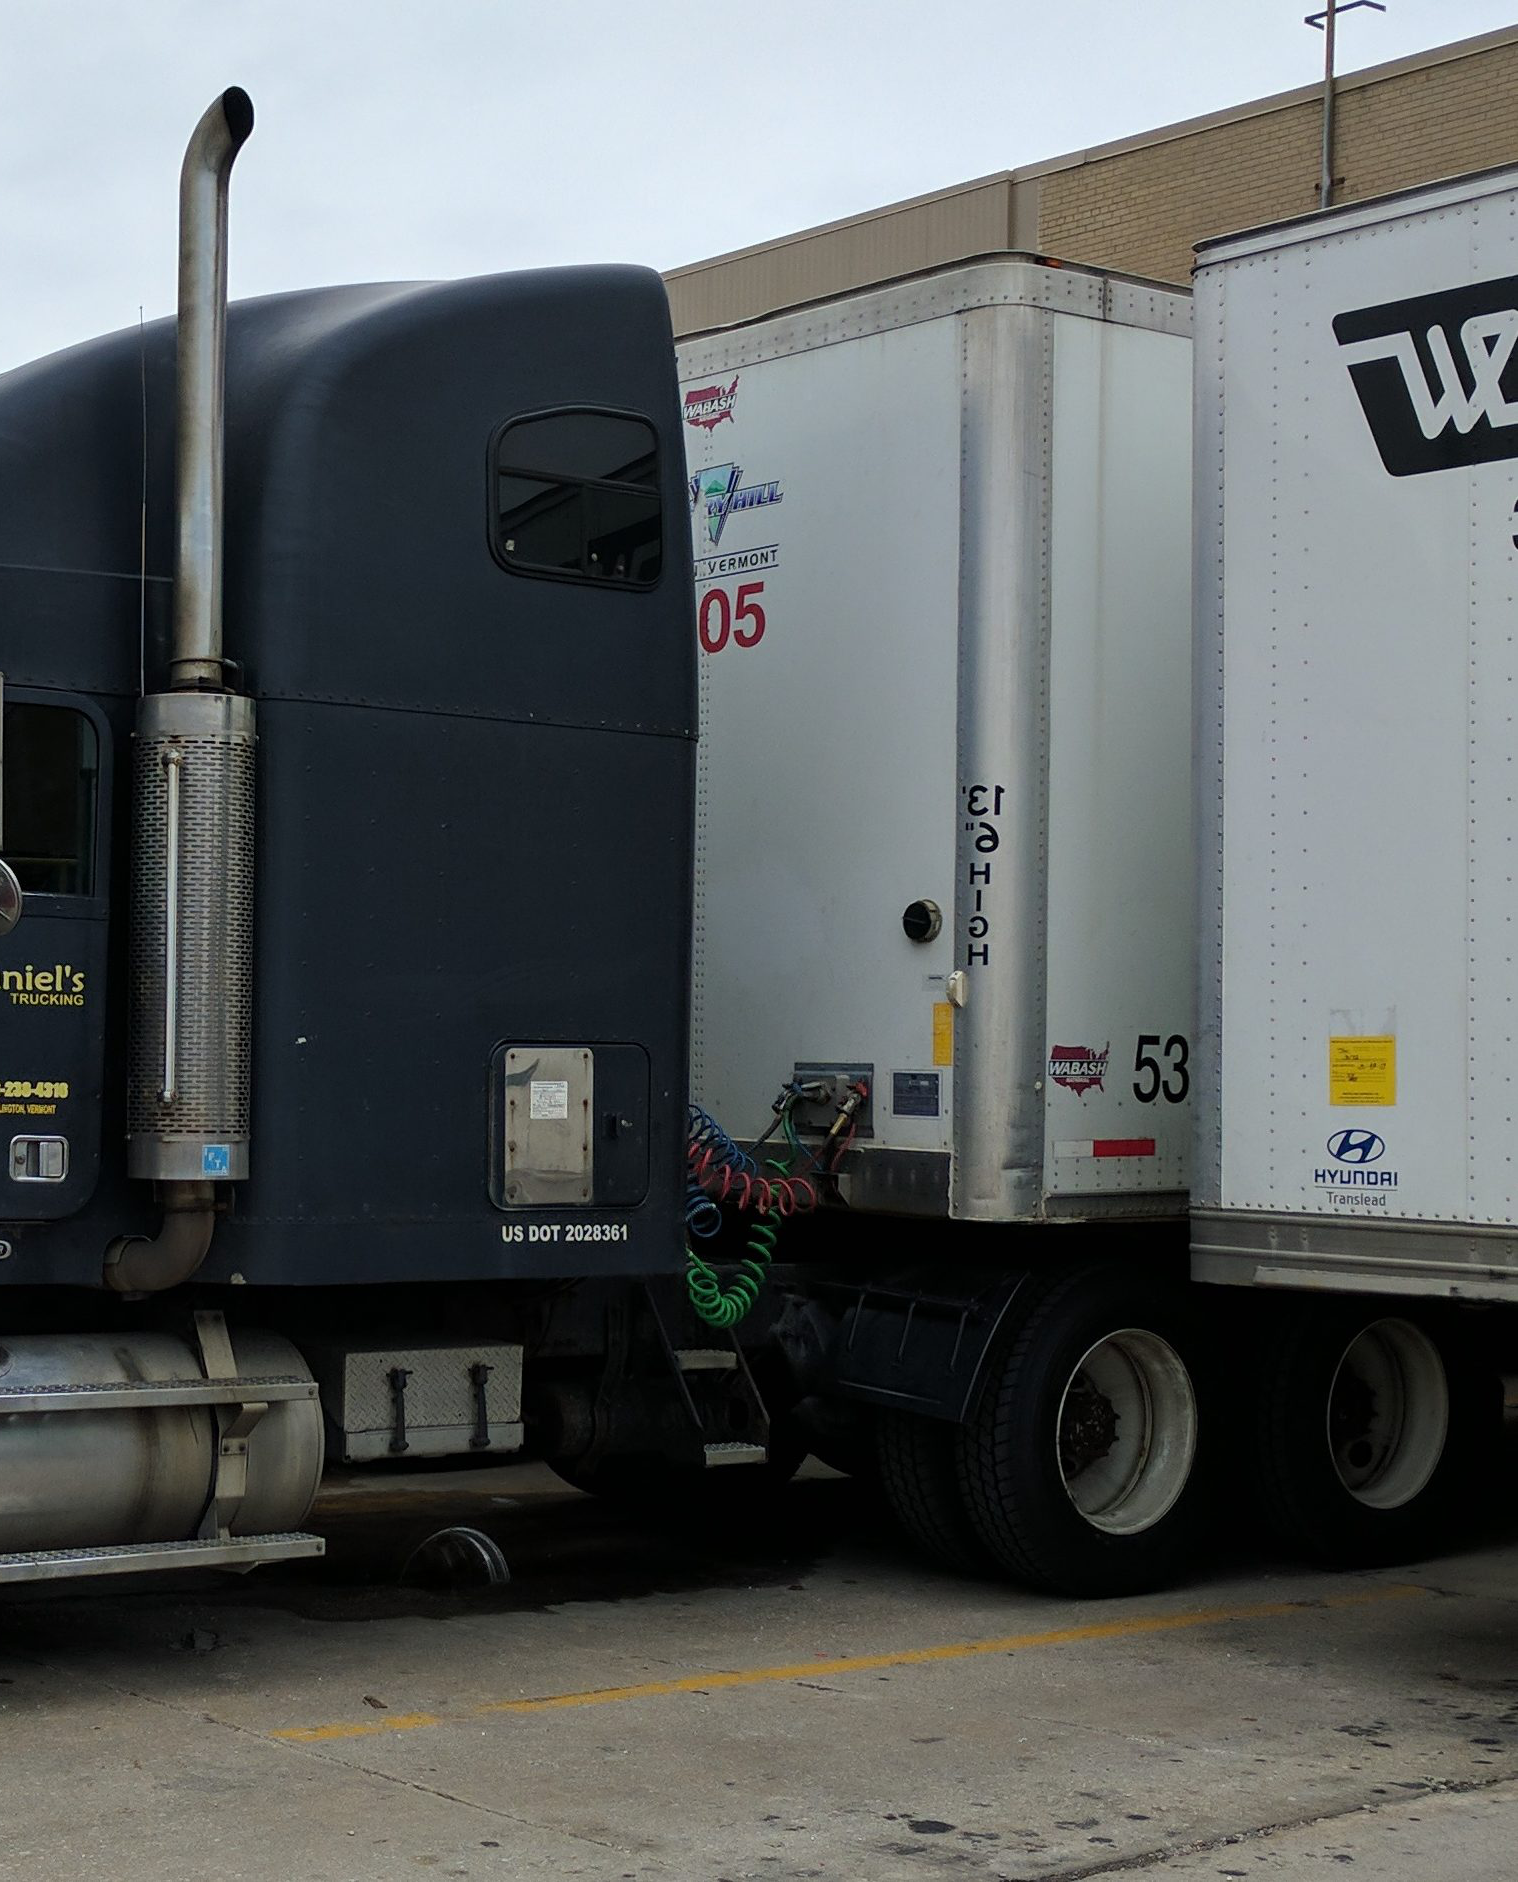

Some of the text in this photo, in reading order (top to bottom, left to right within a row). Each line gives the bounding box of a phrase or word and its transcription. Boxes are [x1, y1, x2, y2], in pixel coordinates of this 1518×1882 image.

[683, 394, 737, 419] WABASH
[731, 482, 783, 511] HILL
[708, 549, 778, 573] VERMONT
[699, 581, 765, 653] 05
[10, 993, 84, 1006] TRUCKING
[1049, 1061, 1108, 1076] WABASH
[1133, 1034, 1190, 1103] 53
[1314, 1169, 1398, 1186] HYUNDAI
[1326, 1191, 1386, 1206] Translead
[502, 1224, 628, 1242] US DOT 2028361
